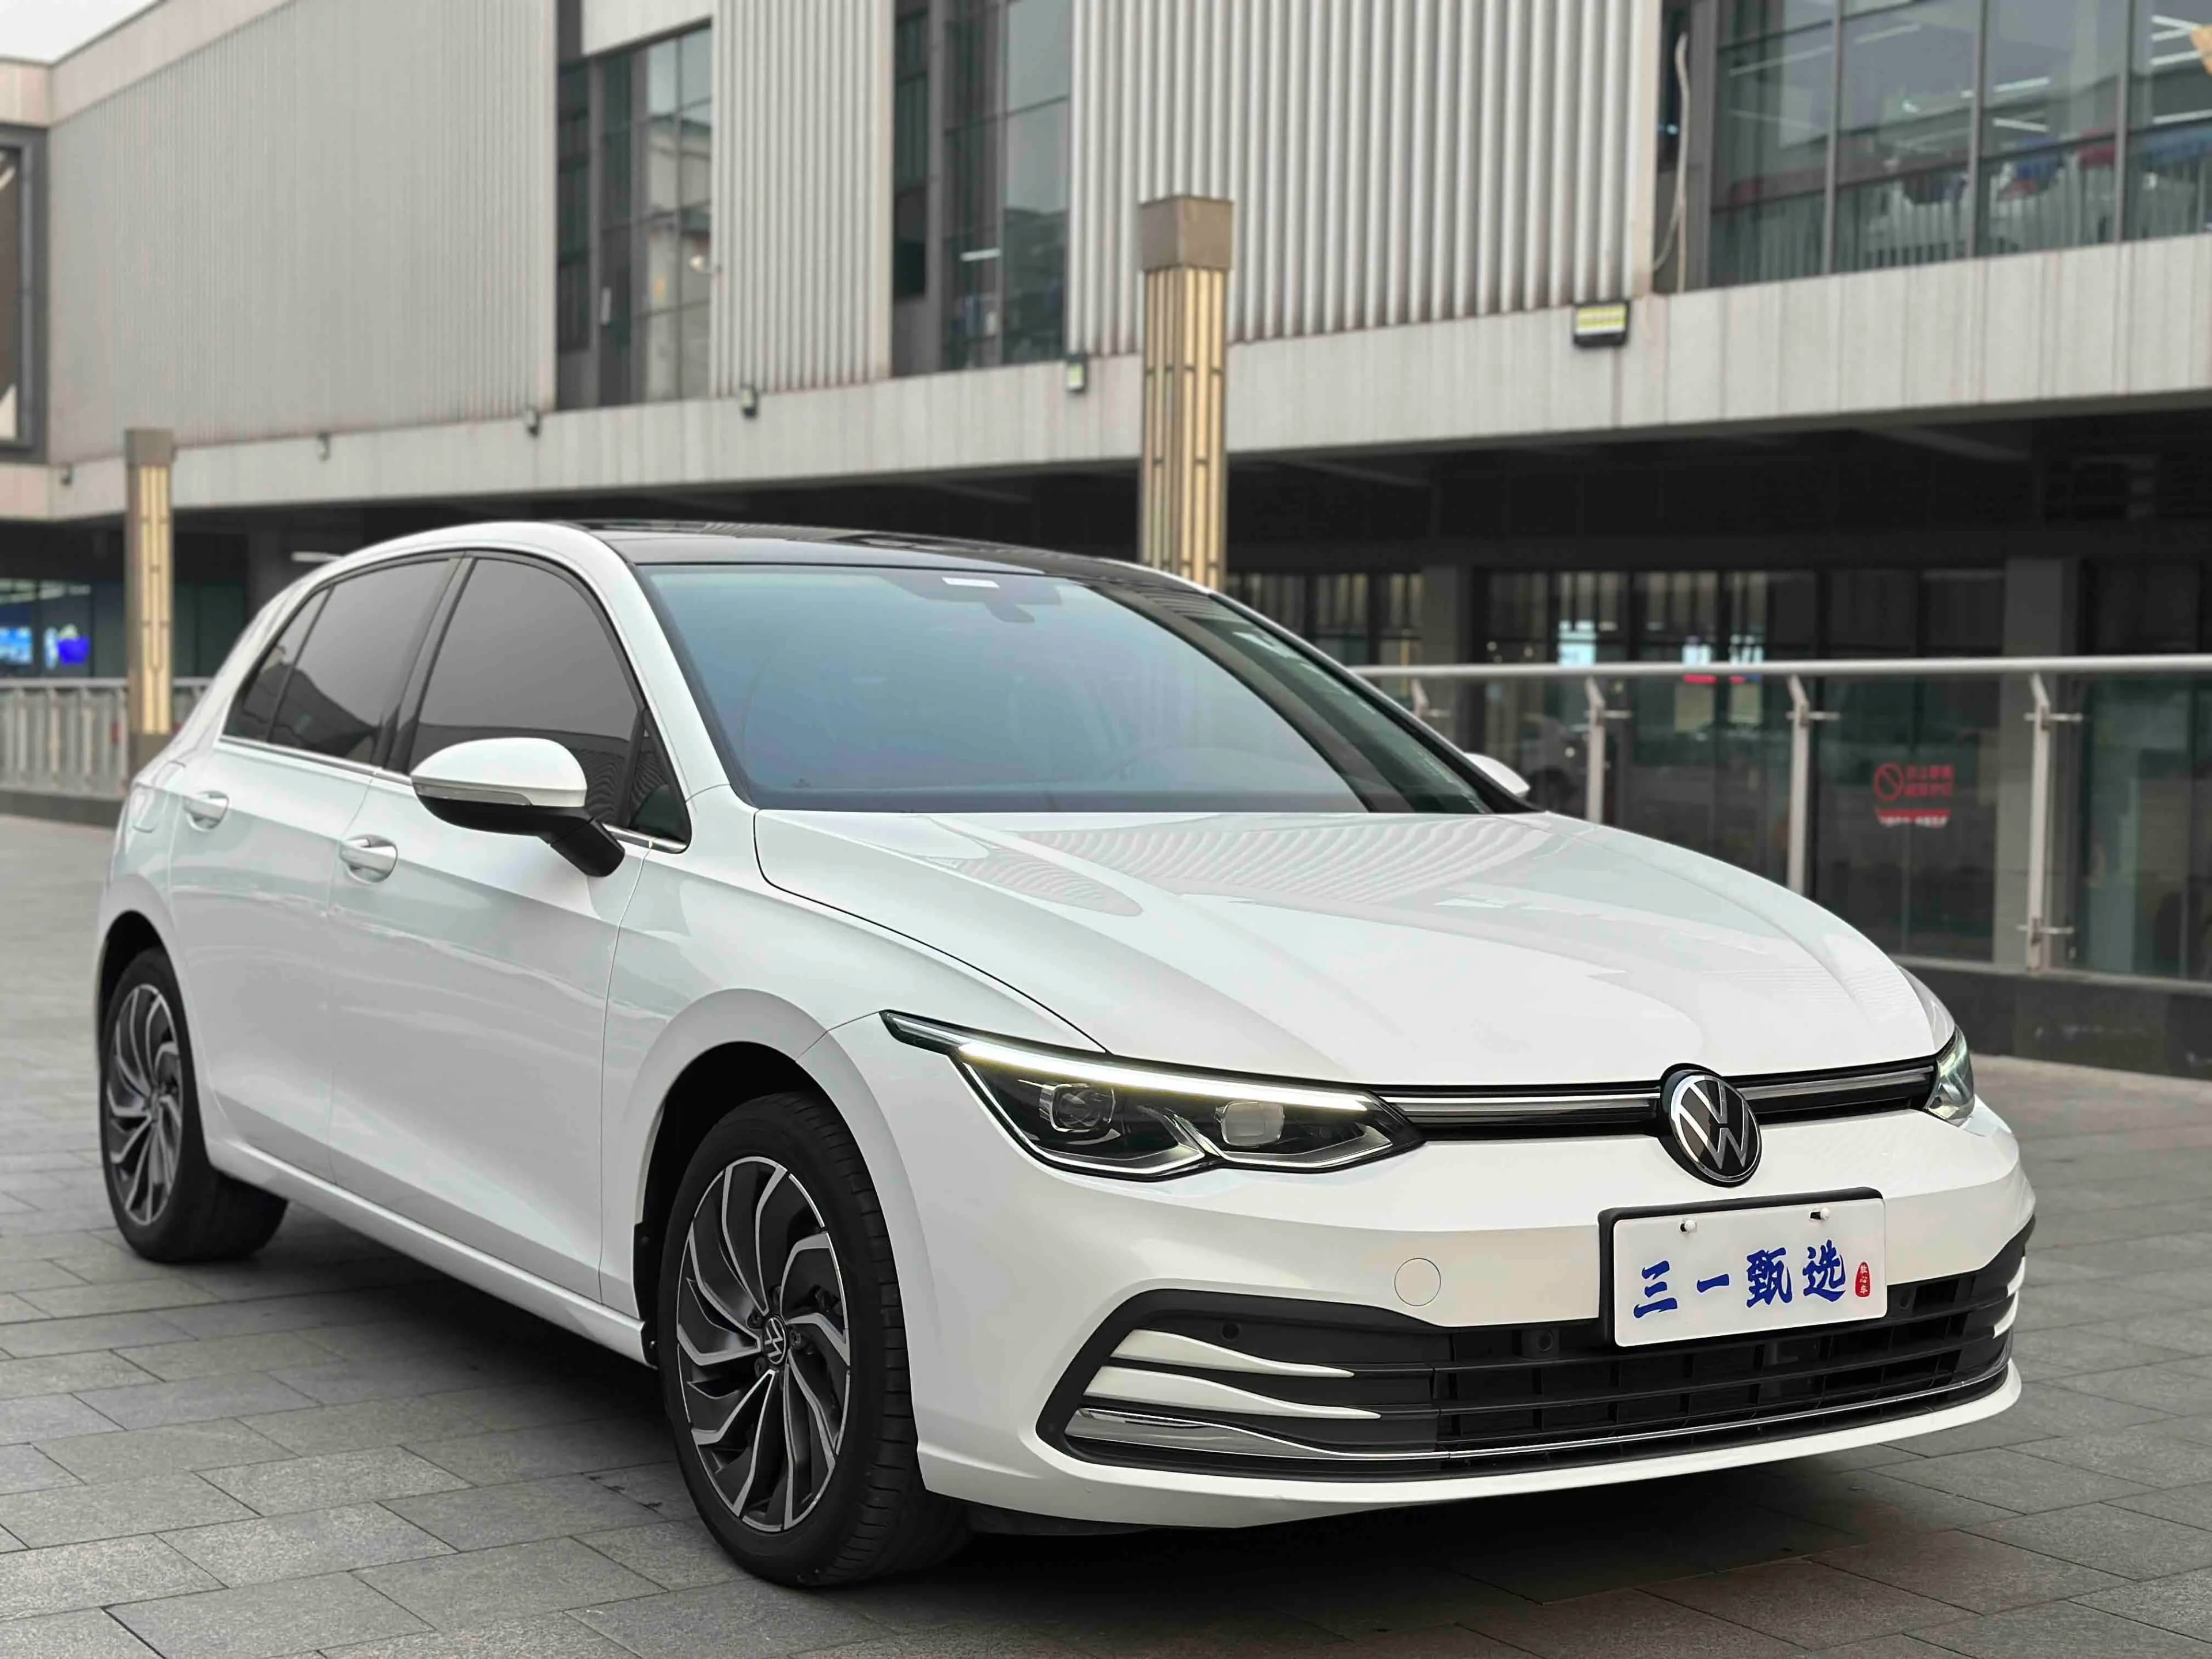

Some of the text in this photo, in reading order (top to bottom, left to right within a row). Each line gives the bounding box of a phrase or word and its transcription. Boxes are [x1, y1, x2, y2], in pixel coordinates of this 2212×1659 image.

[1675, 1078, 1757, 1175] VW
[1633, 1239, 1846, 1319] 三一甄选
